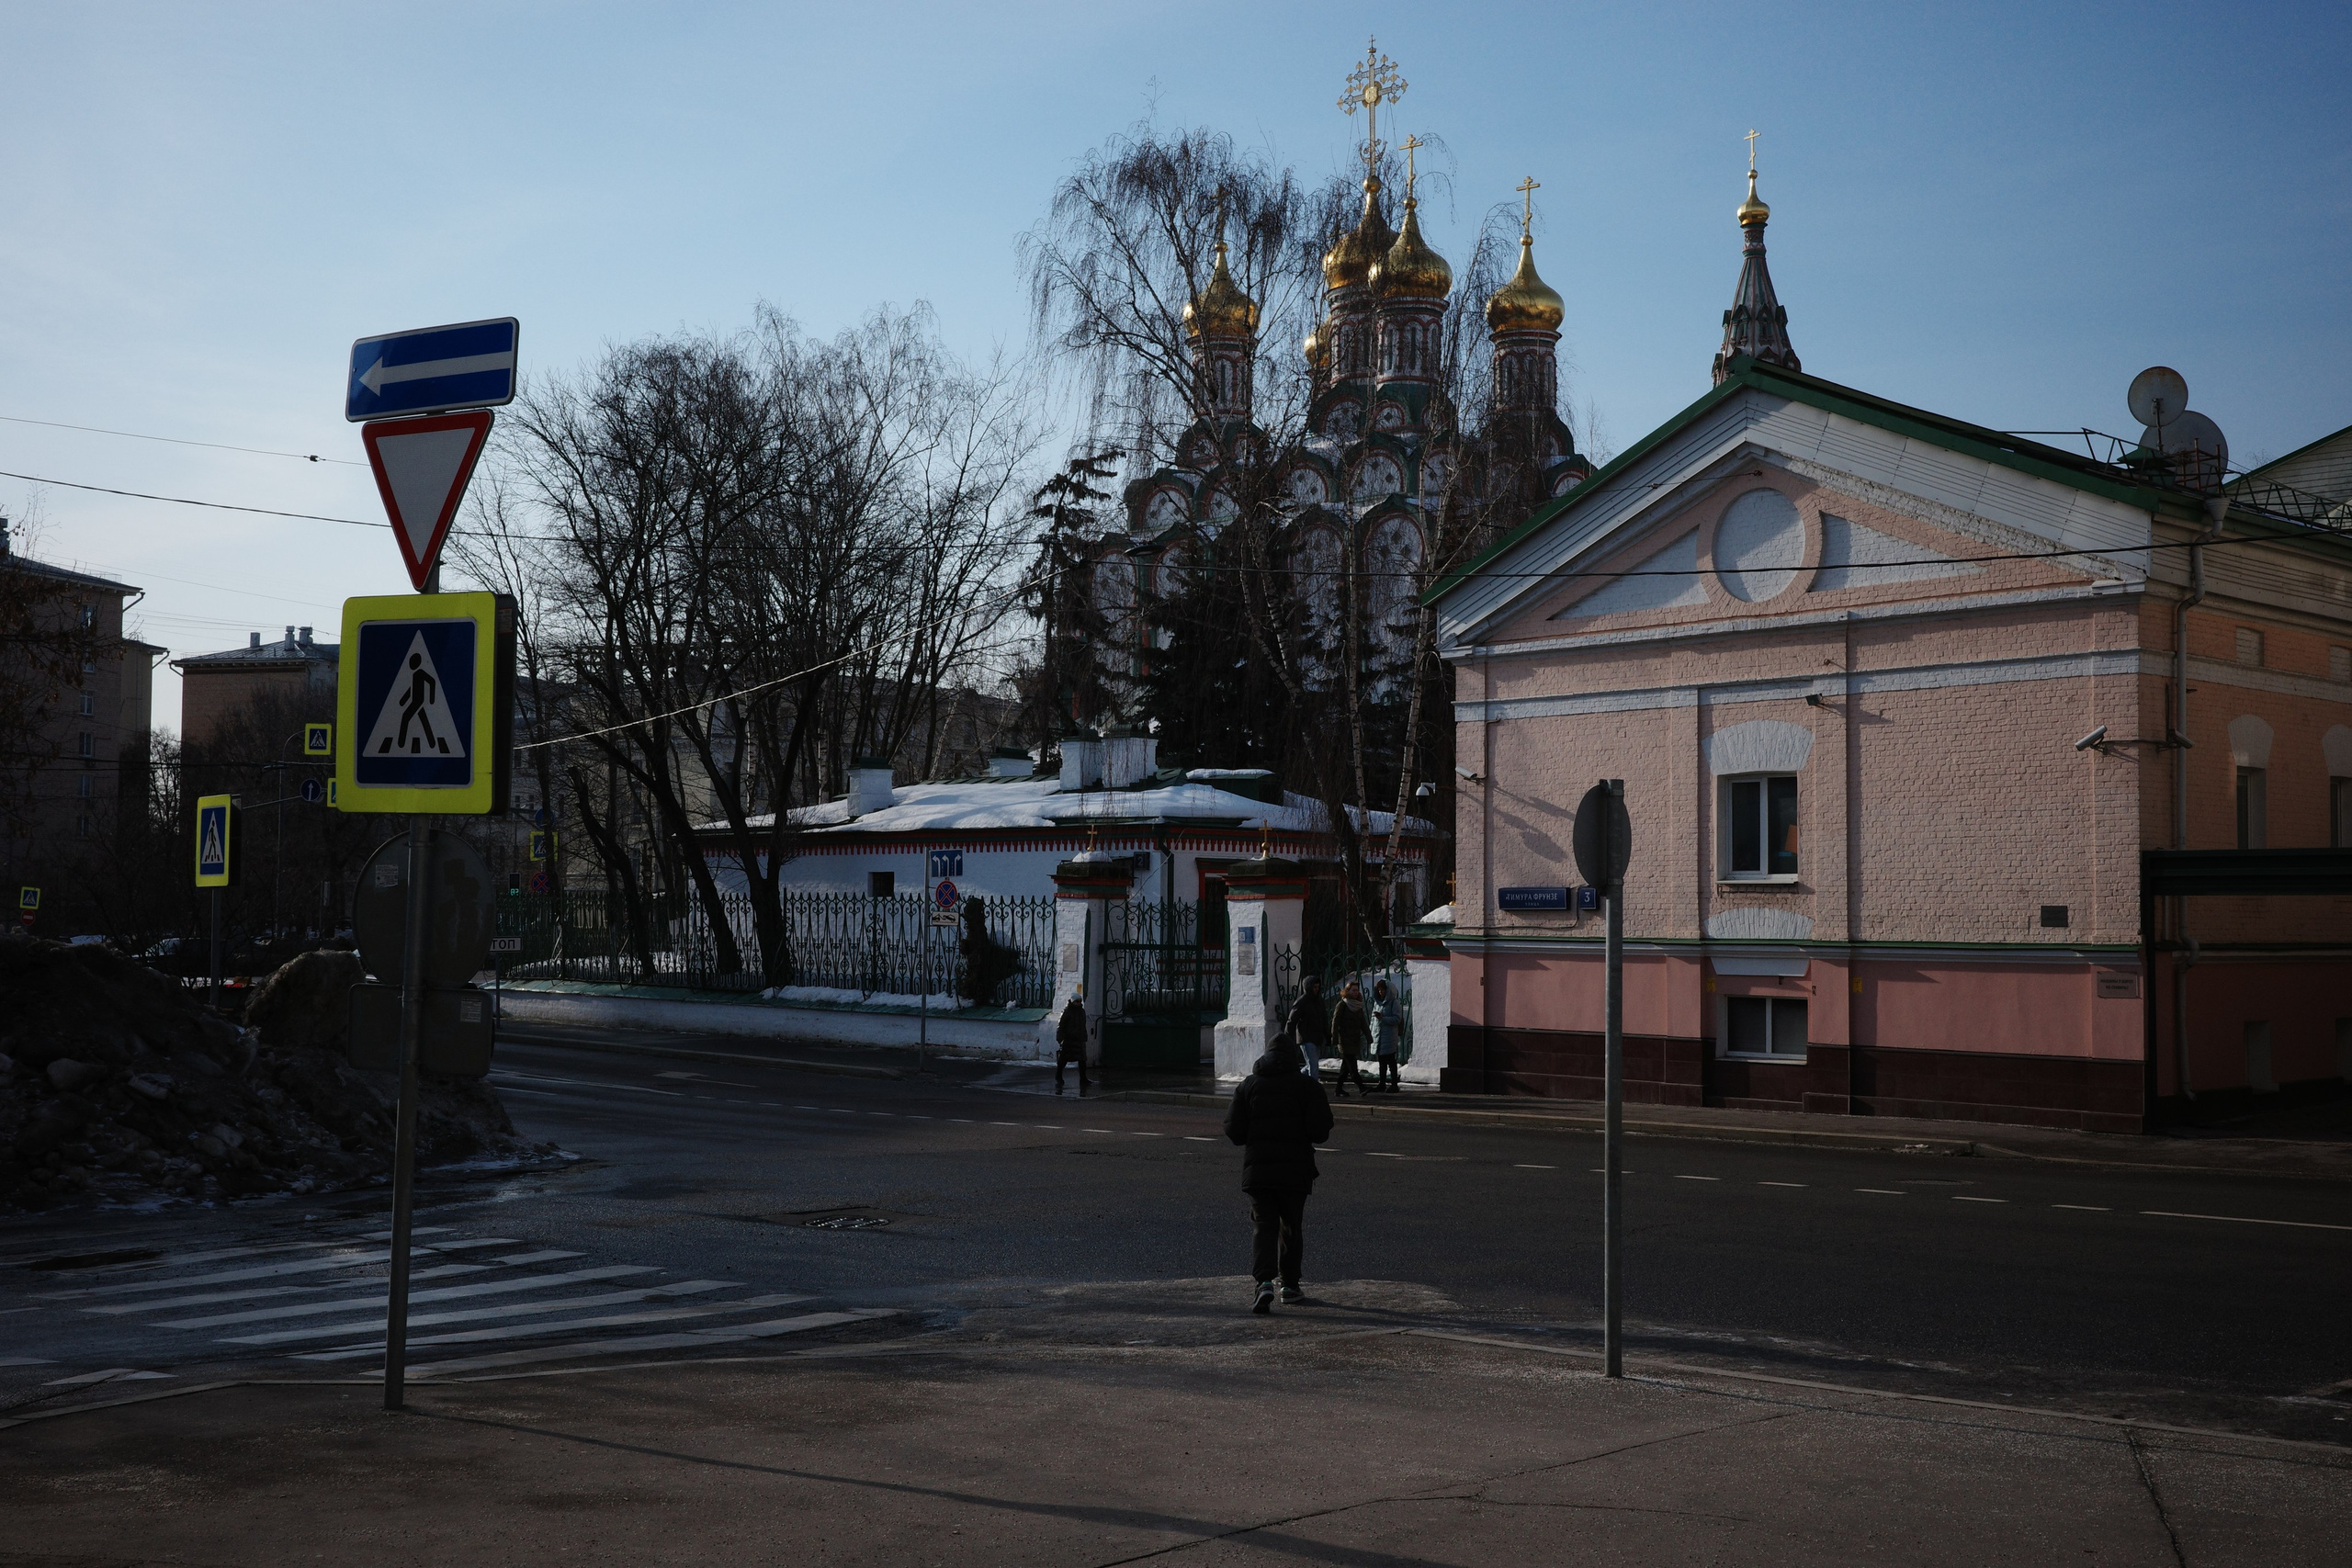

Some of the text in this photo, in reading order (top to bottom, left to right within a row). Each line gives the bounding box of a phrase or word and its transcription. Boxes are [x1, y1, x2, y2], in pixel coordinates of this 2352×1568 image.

[1506, 892, 1558, 901] ТИМУРА ФРУНЗЕ
[1584, 892, 1590, 902] 3
[492, 939, 515, 950] ТОП
